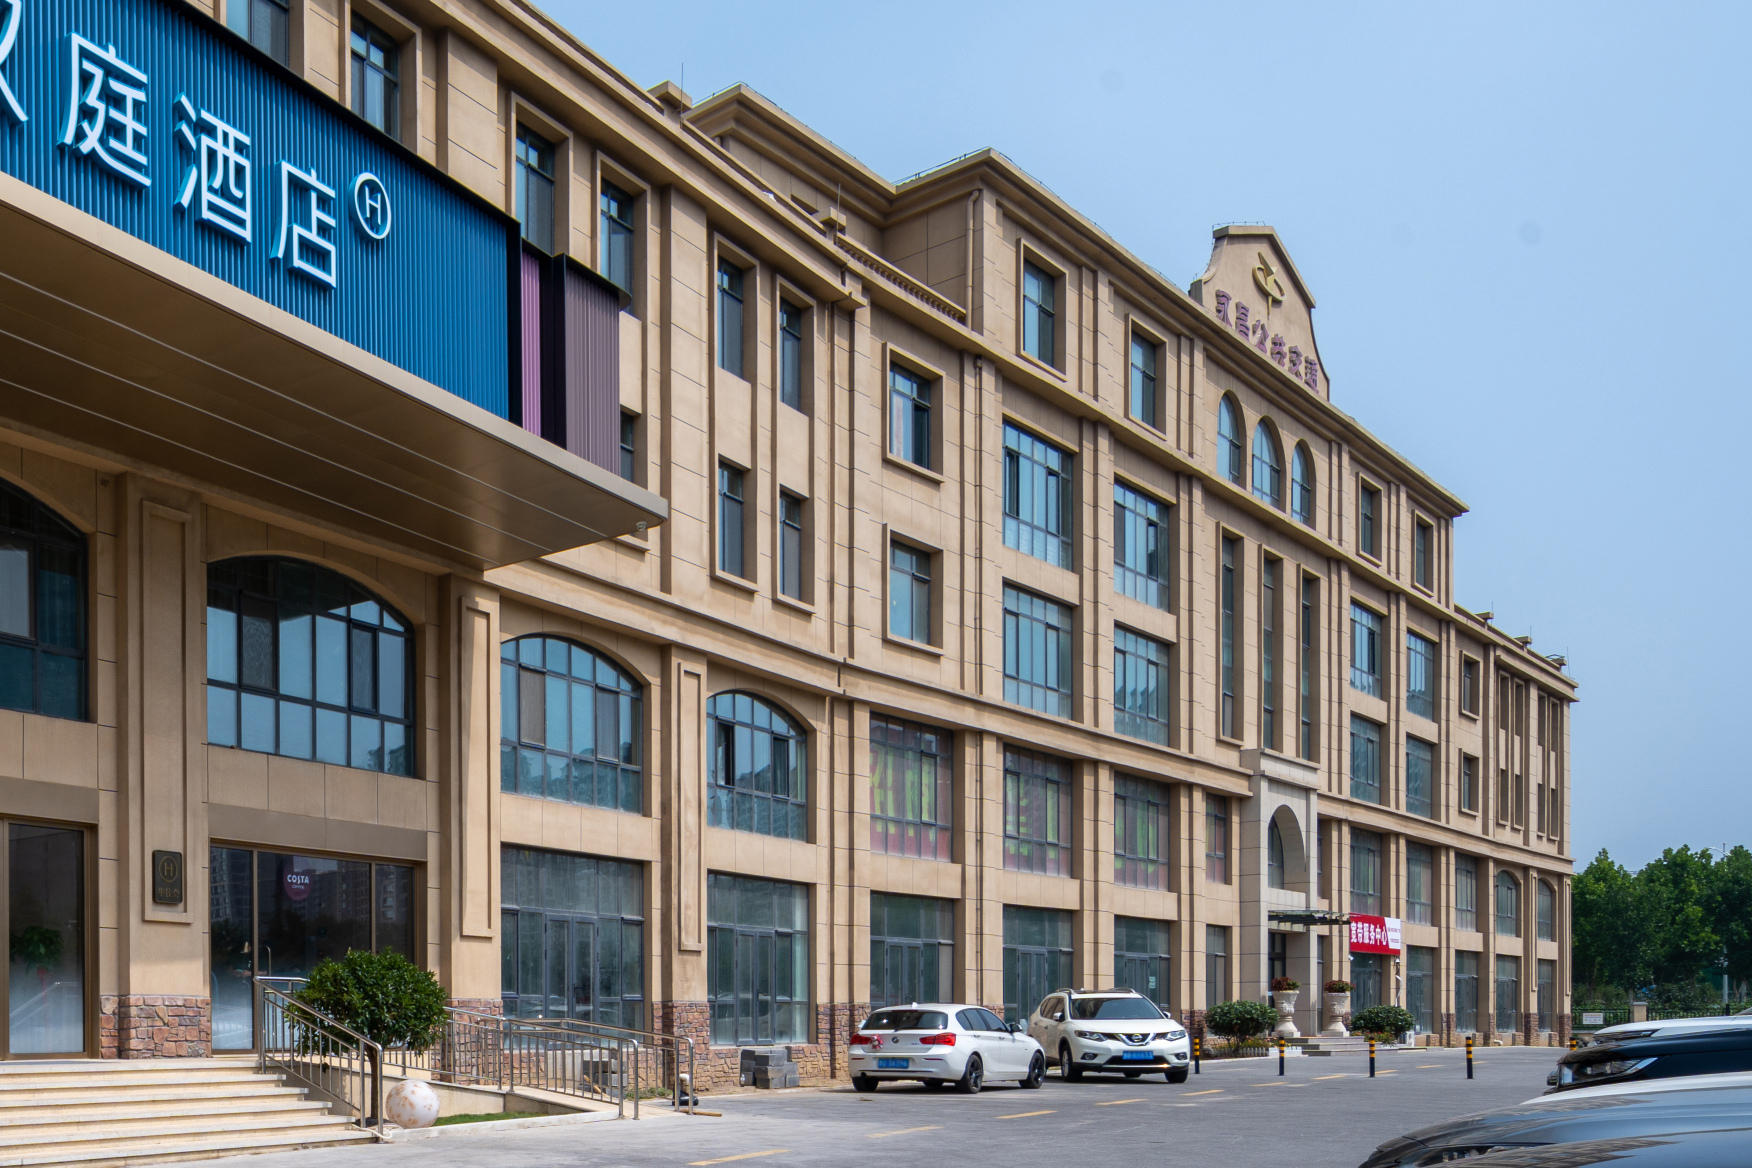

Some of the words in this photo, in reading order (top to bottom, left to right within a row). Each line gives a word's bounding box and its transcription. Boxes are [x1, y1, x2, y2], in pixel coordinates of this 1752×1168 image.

[287, 874, 310, 885] COSTA
[1350, 921, 1387, 945] 宽带服务中心
